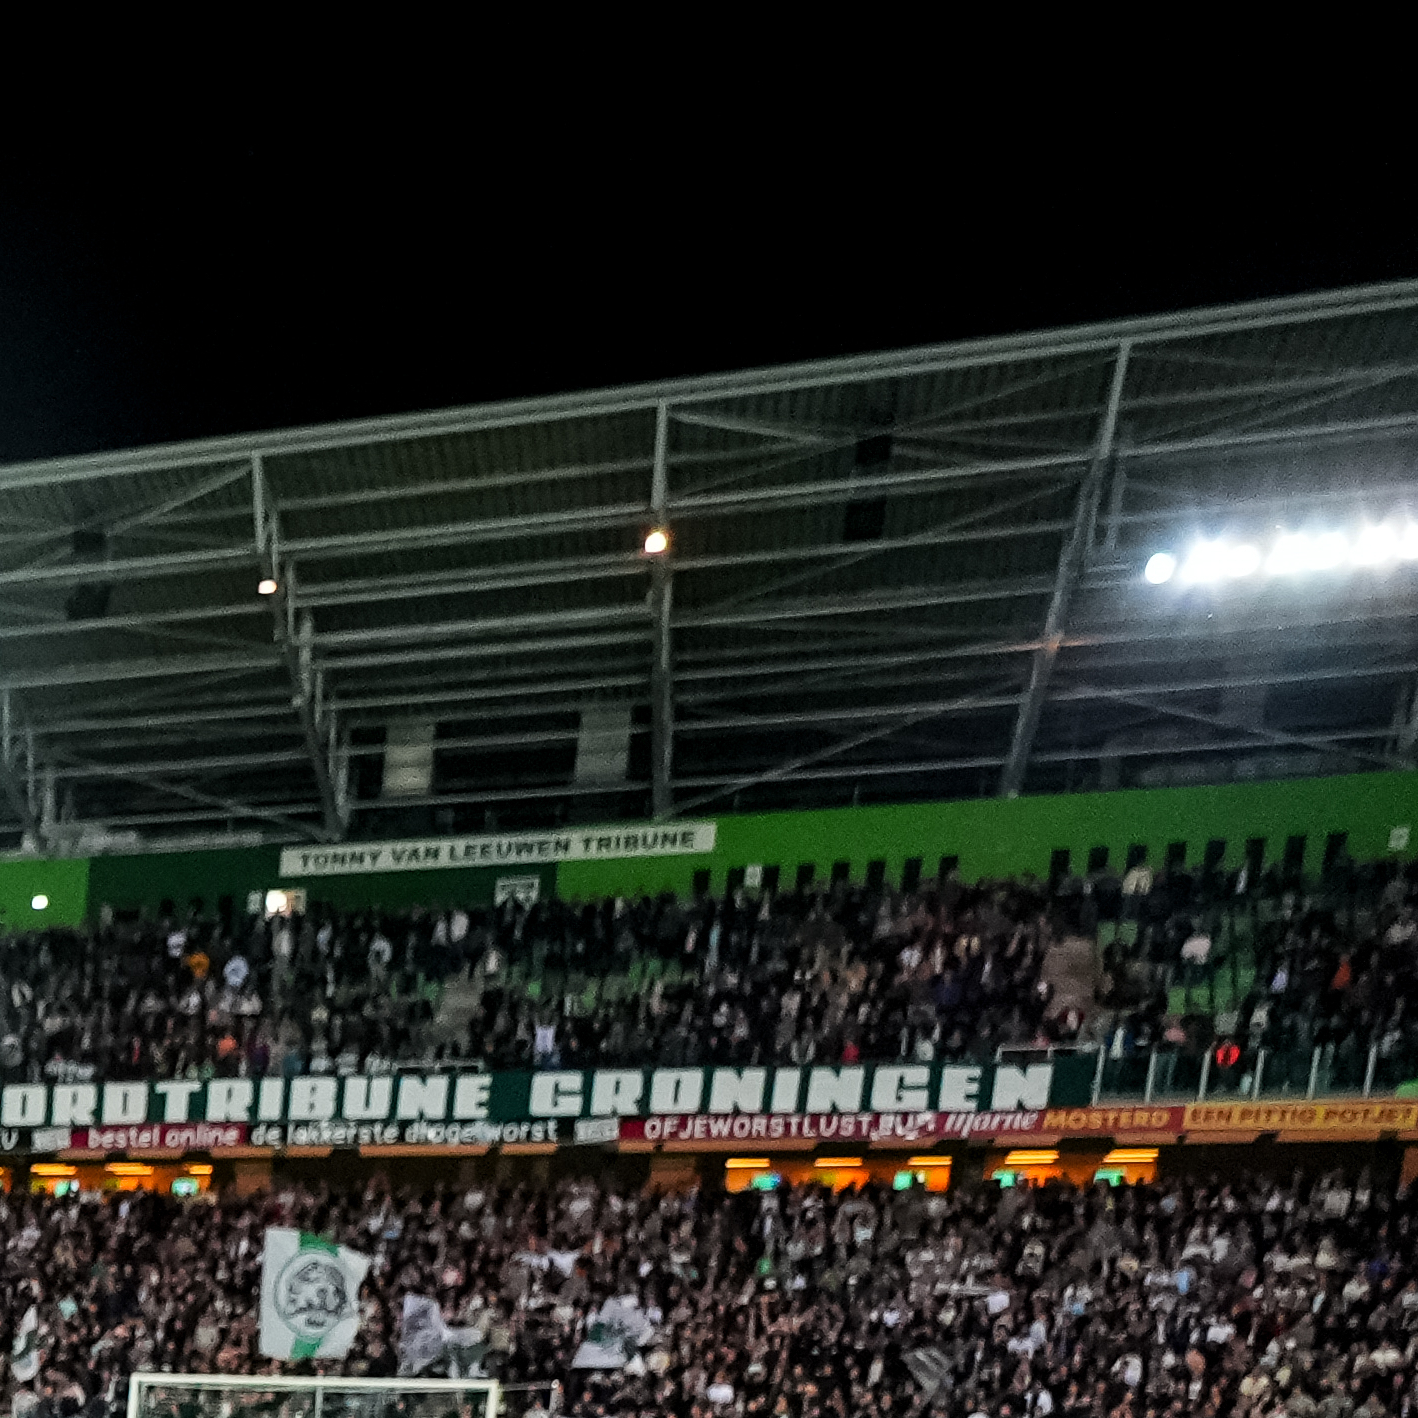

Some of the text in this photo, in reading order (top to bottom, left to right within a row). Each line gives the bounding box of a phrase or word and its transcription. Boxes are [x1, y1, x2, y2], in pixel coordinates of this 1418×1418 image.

[528, 1063, 1053, 1119] GRONINGEN
[87, 1125, 161, 1149] bestel
[165, 1122, 239, 1147] online
